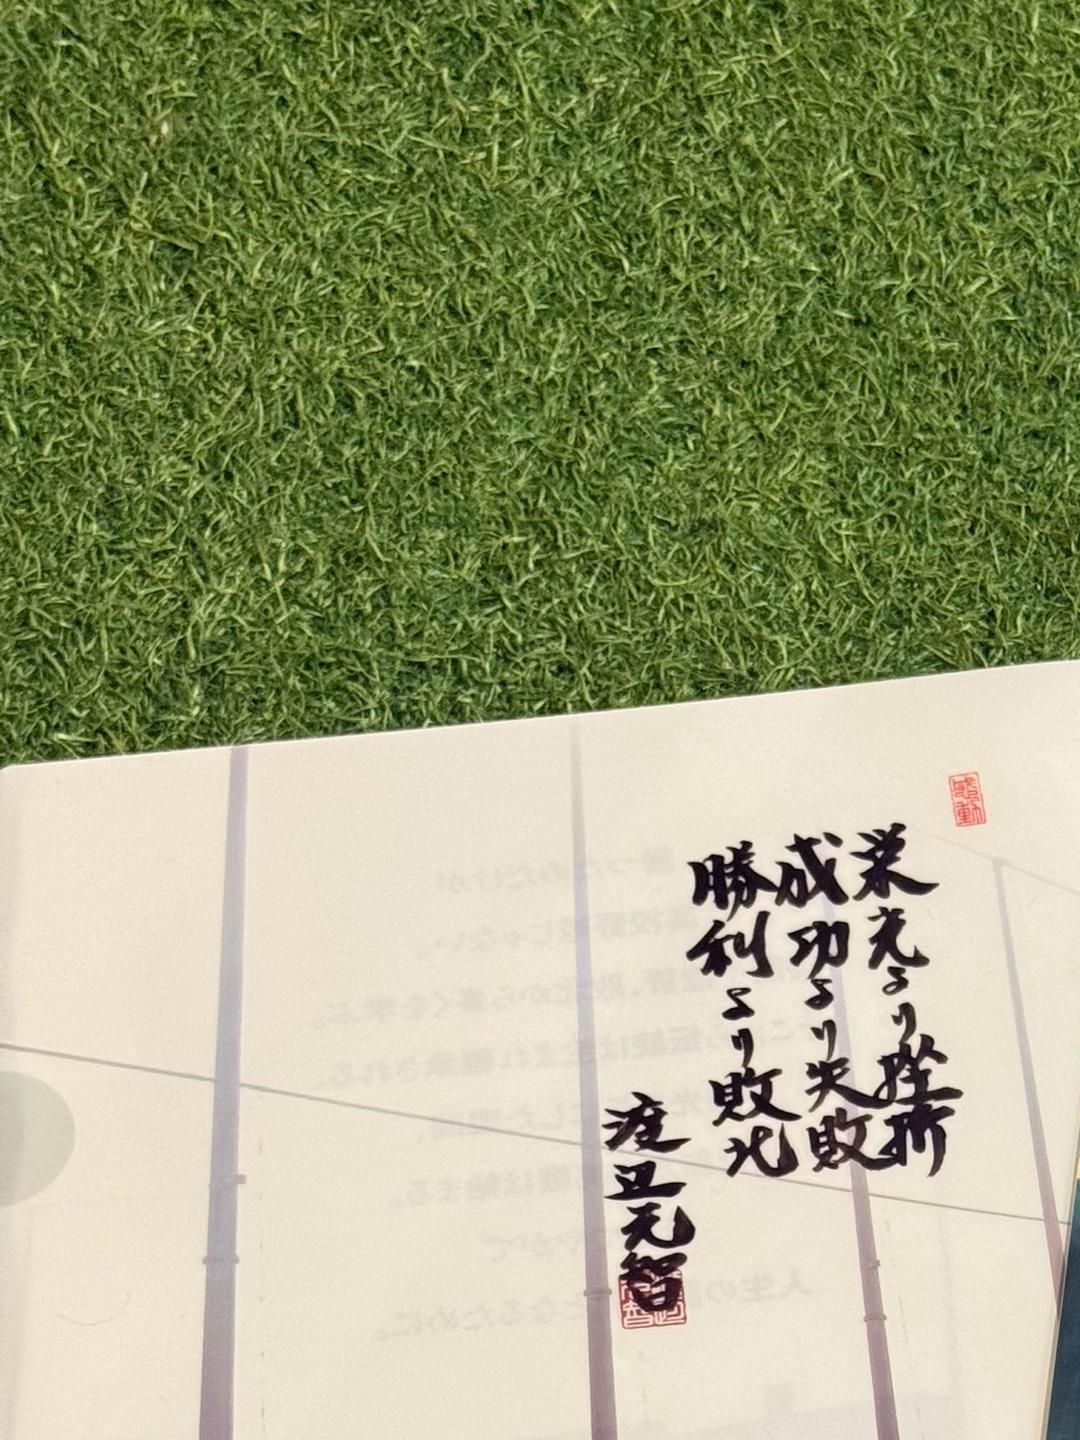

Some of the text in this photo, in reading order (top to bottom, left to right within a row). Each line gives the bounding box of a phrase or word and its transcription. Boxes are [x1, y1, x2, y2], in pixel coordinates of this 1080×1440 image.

[686, 840, 802, 1178] 勝利より敗北
[776, 832, 889, 1176] 成功より失敗
